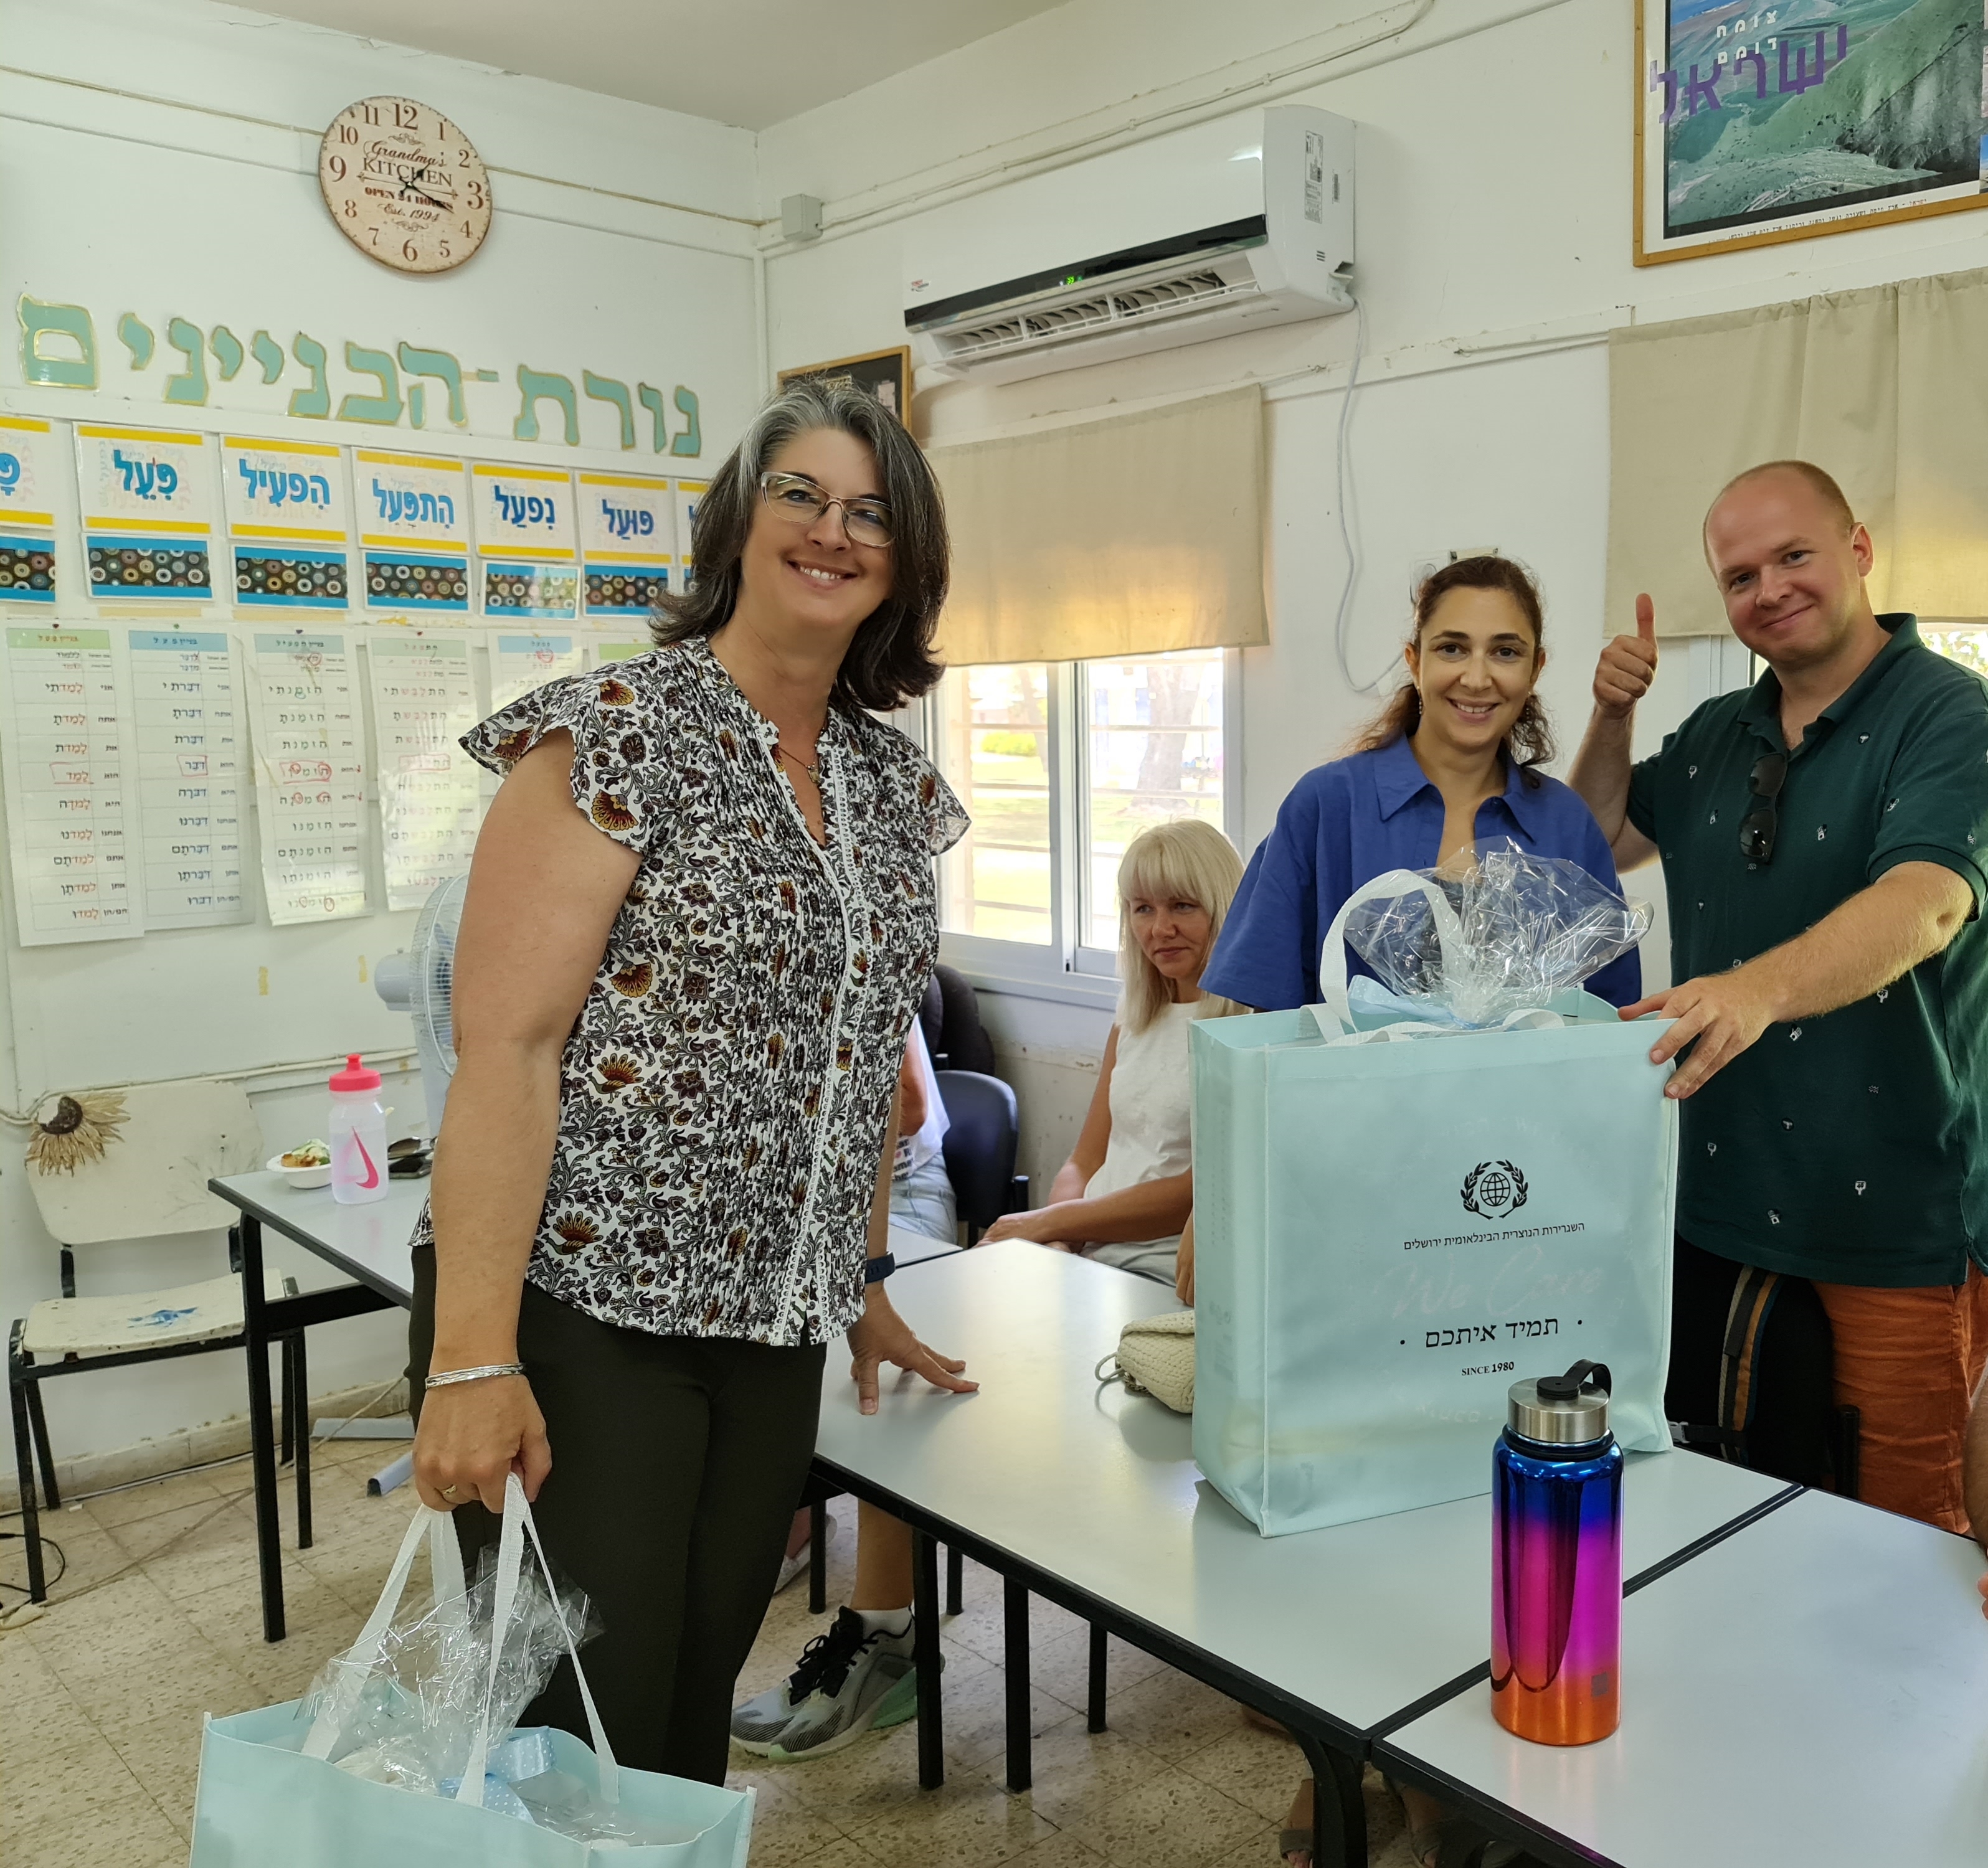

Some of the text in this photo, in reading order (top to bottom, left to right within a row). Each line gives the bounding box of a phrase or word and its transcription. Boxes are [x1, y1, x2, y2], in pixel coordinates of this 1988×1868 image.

[1716, 10, 1777, 38] צומח
[1718, 37, 1777, 65] דומם
[1649, 24, 1847, 123] ישראל
[363, 105, 381, 126] 11
[392, 103, 419, 130] 12
[339, 124, 359, 145] 10
[437, 121, 446, 141] 1
[329, 155, 347, 182] 9
[458, 149, 470, 168] 2
[362, 158, 453, 187] KITCHEN
[466, 181, 484, 210] 3
[344, 199, 357, 218] 8
[368, 227, 380, 247] 7
[460, 220, 473, 238] 4
[402, 238, 419, 262] 6
[439, 240, 451, 258] 5
[1403, 1222, 1585, 1250] השגרירות הנוצרית הבינלאומית ירושלים
[1425, 1318, 1559, 1348] תמיד איתכם
[1461, 1361, 1515, 1376] SINCE 1980
